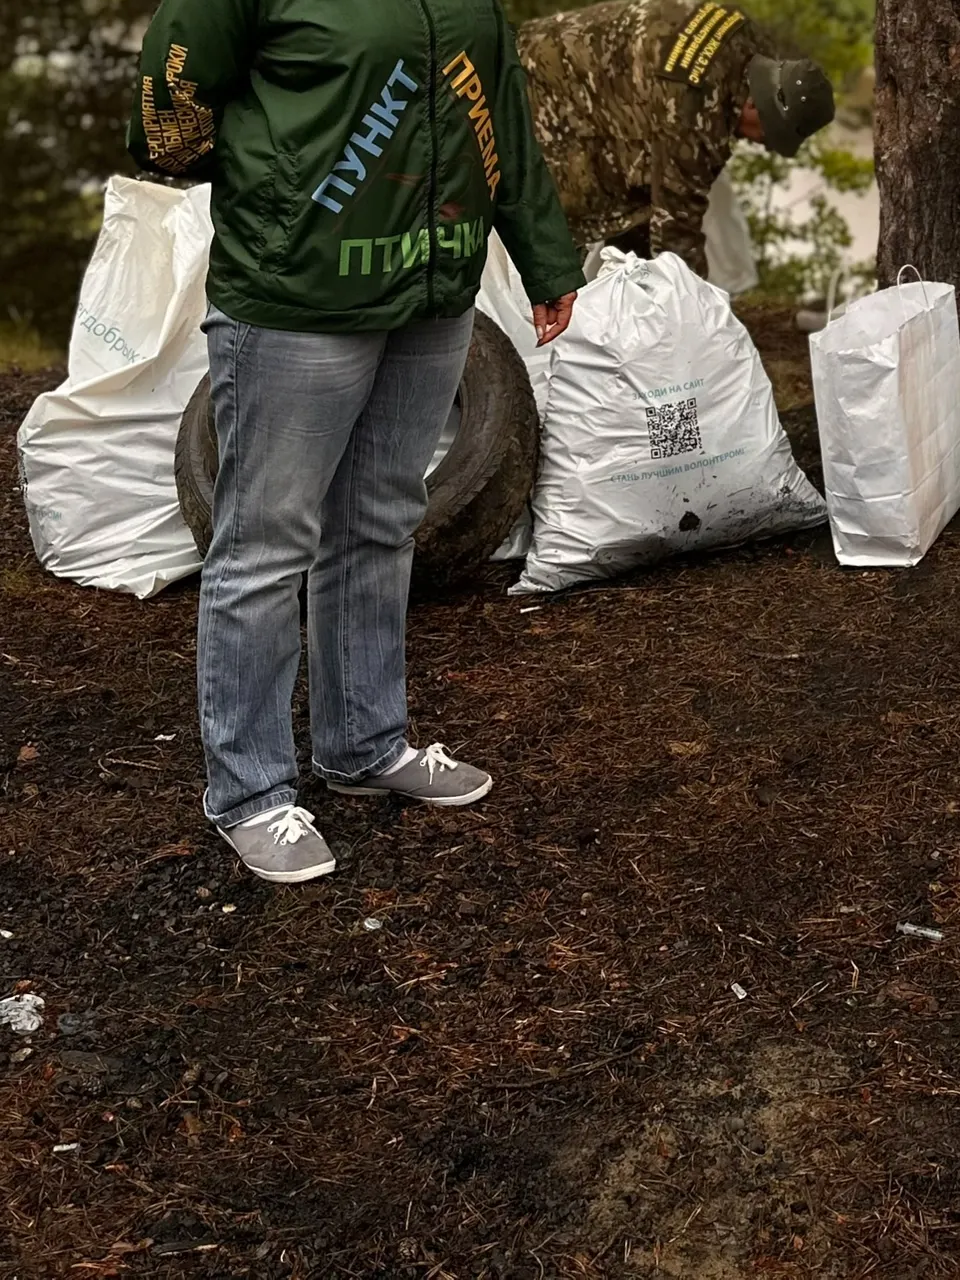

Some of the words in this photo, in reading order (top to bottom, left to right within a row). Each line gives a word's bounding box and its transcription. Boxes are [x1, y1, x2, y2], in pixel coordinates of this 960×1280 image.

[664, 32, 689, 73] района
[311, 59, 419, 213] ПУНКТ
[442, 51, 501, 201] ПРИЕМА
[338, 217, 486, 276] ПТИЧКА
[632, 387, 668, 400] ЗАХОДИ
[669, 384, 682, 395] НА
[683, 378, 704, 391] САЙТ
[610, 471, 640, 483] СТАНЬ
[641, 466, 683, 481] ЛУЧШИМ
